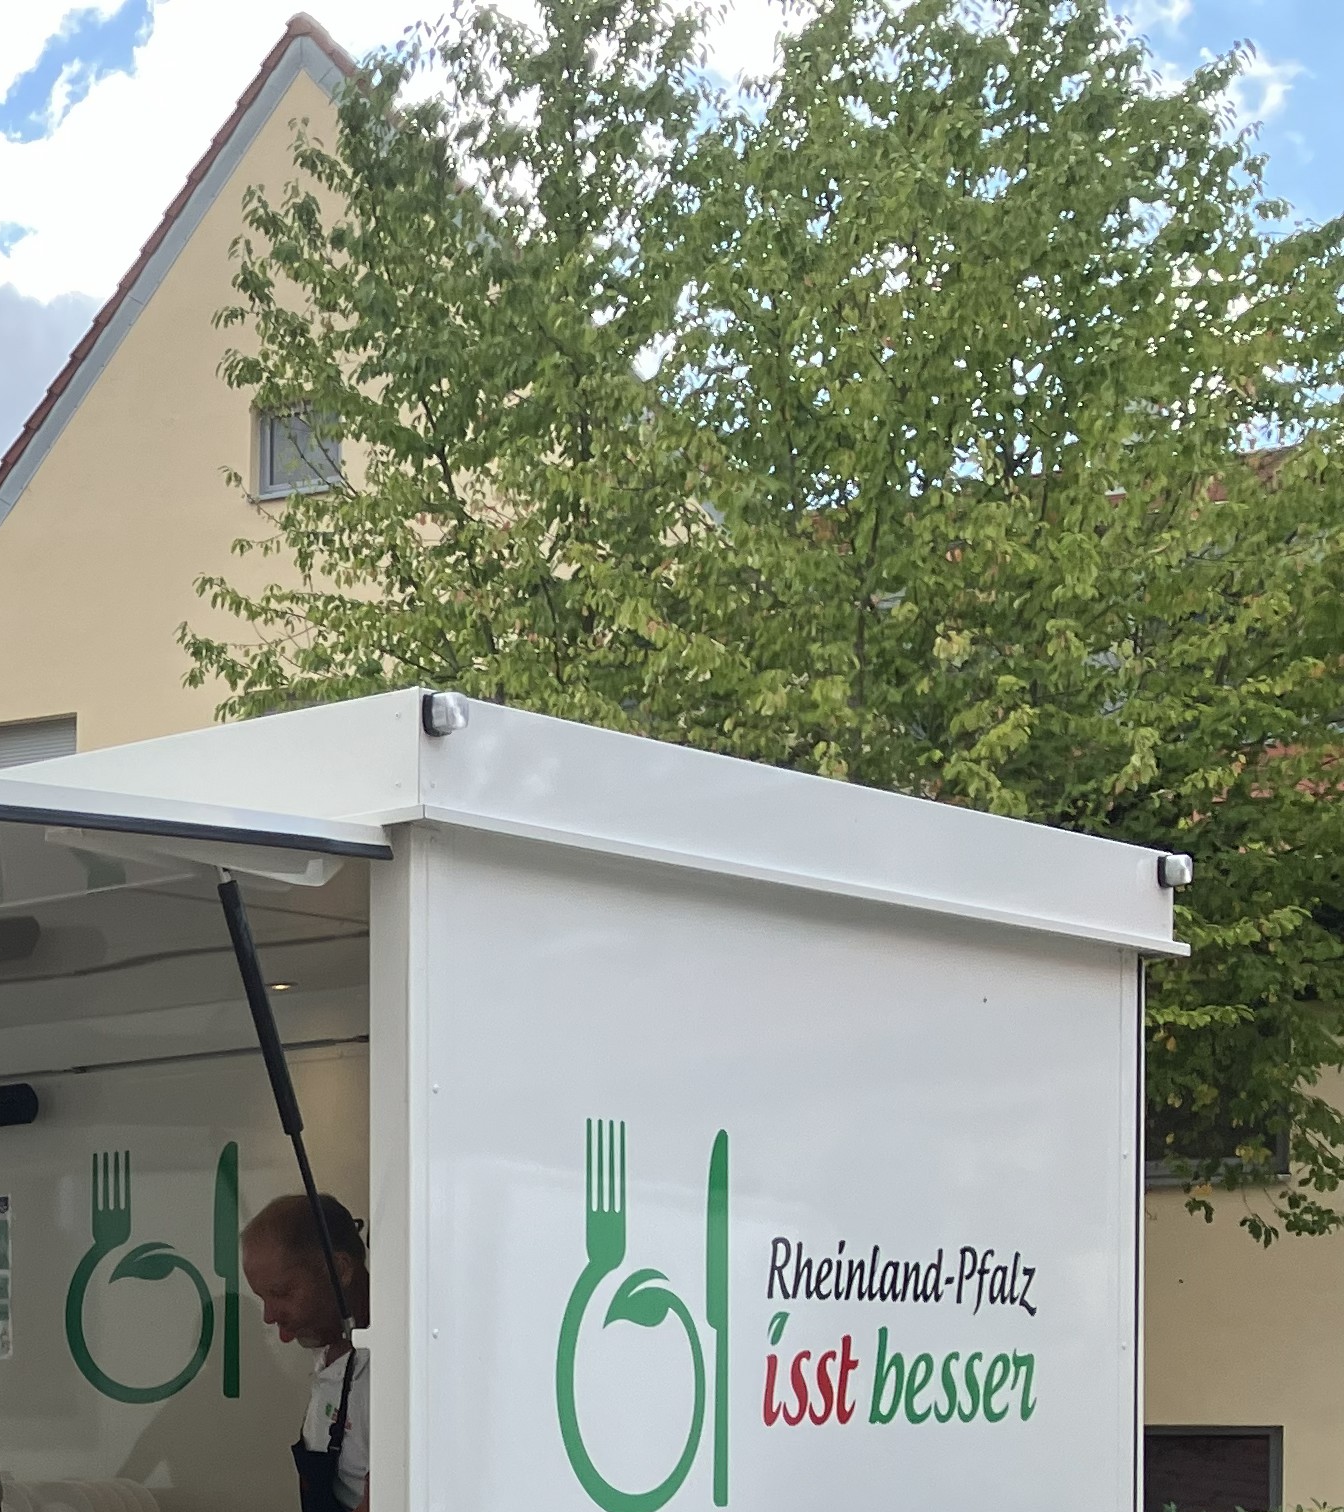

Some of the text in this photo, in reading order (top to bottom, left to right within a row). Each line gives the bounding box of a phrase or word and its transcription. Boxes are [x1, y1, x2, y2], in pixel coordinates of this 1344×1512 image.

[767, 1236, 1038, 1317] Rheinland-Pfalz
[762, 1311, 1038, 1427] isst besser
